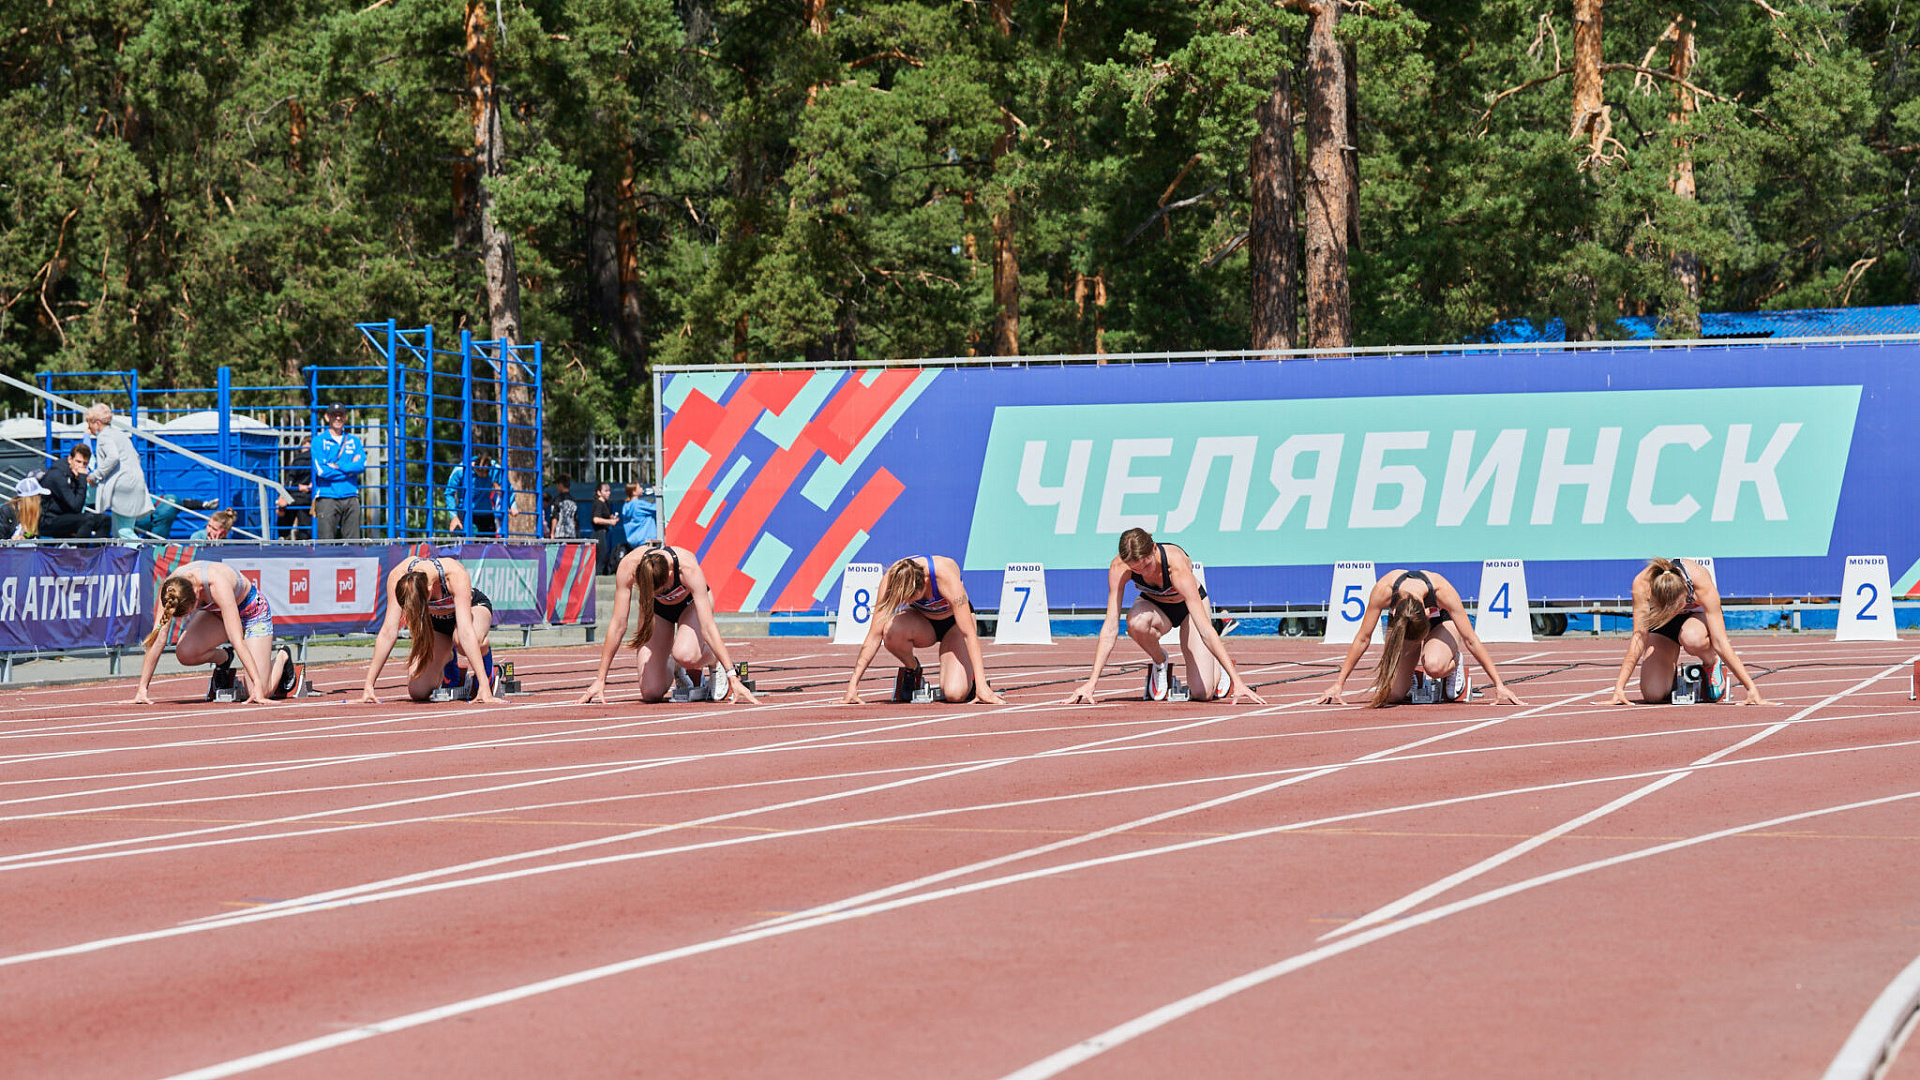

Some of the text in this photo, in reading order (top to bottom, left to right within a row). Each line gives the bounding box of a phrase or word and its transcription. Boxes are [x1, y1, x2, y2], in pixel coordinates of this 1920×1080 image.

[1016, 423, 1803, 534] ЧЕЛЯБИНСК
[22, 573, 140, 620] АТЛЕТИКА
[853, 589, 870, 623] 8
[1014, 587, 1030, 622] 7
[1341, 586, 1365, 622] 5
[1489, 583, 1512, 619] 4
[1856, 583, 1878, 620] 2
